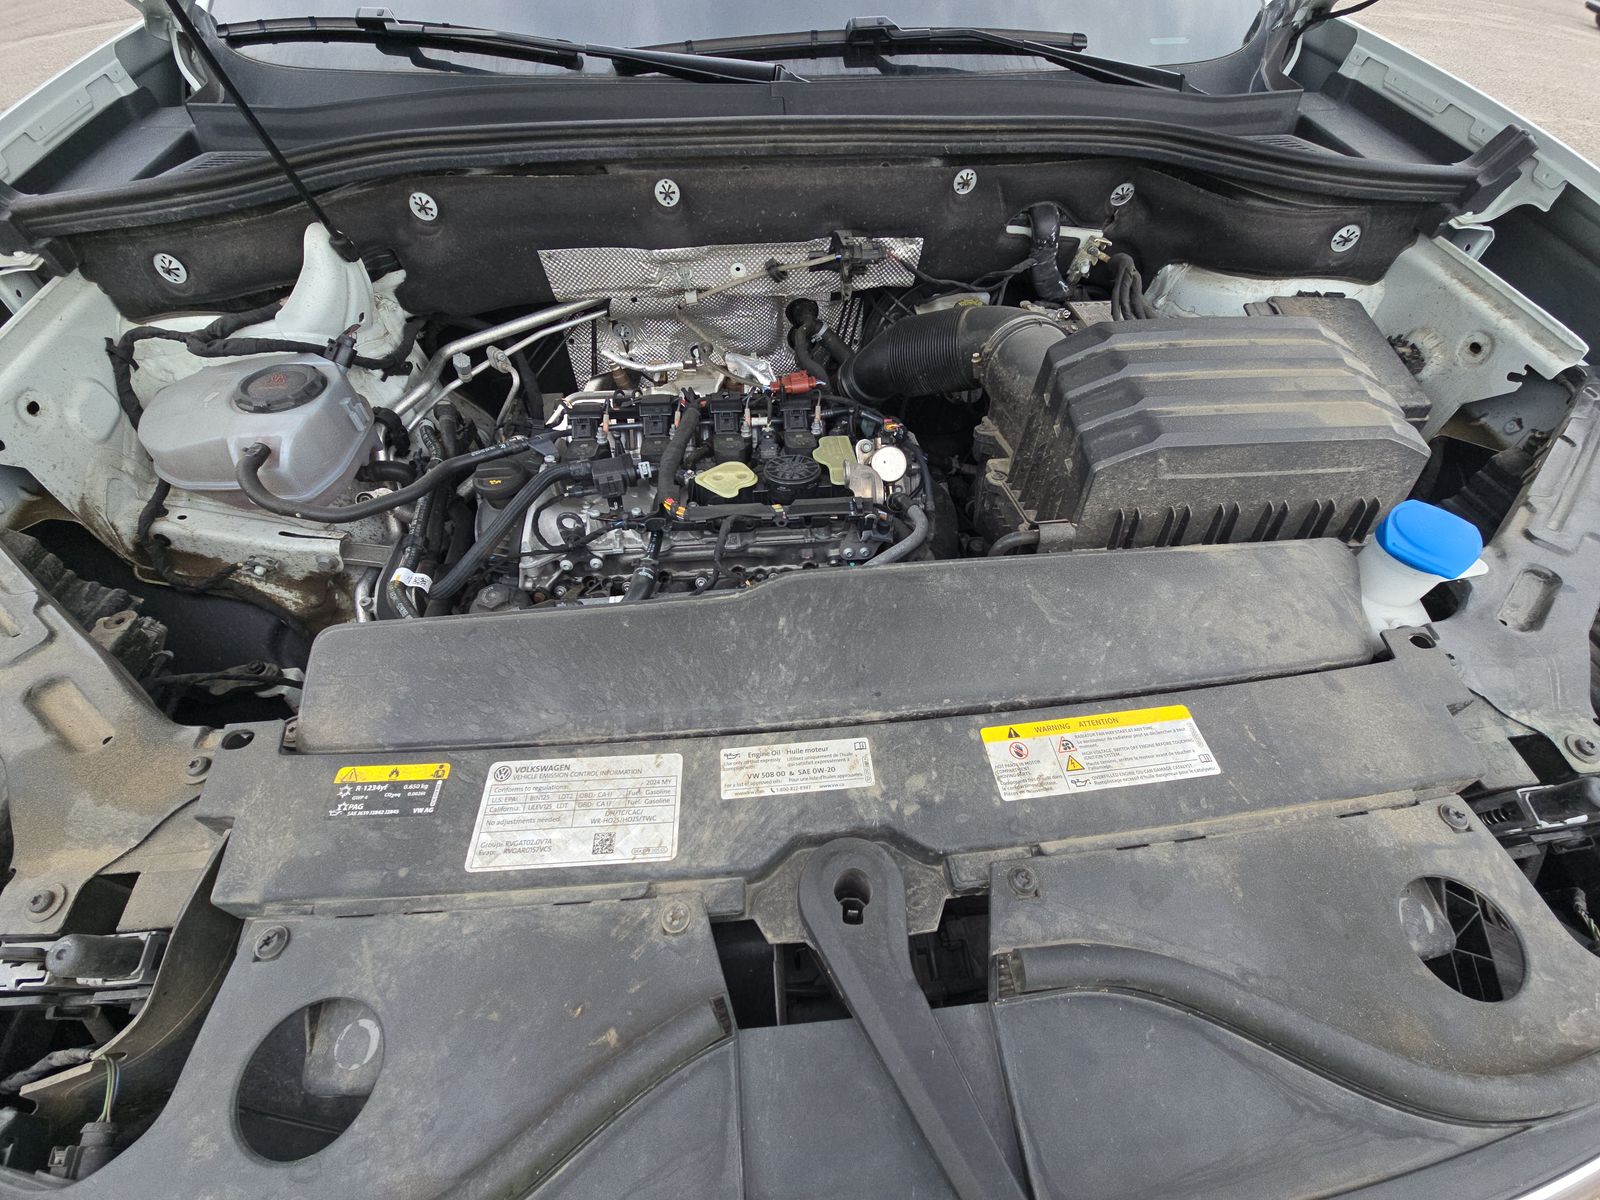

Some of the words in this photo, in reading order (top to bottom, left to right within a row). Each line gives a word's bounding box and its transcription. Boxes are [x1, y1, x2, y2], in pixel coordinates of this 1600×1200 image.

[1034, 723, 1071, 733] WARNING
[1078, 717, 1119, 727] ATTENTION
[748, 750, 770, 759] Engine
[514, 764, 570, 773] VOLKSWAGEN
[496, 817, 536, 826] adjustments
